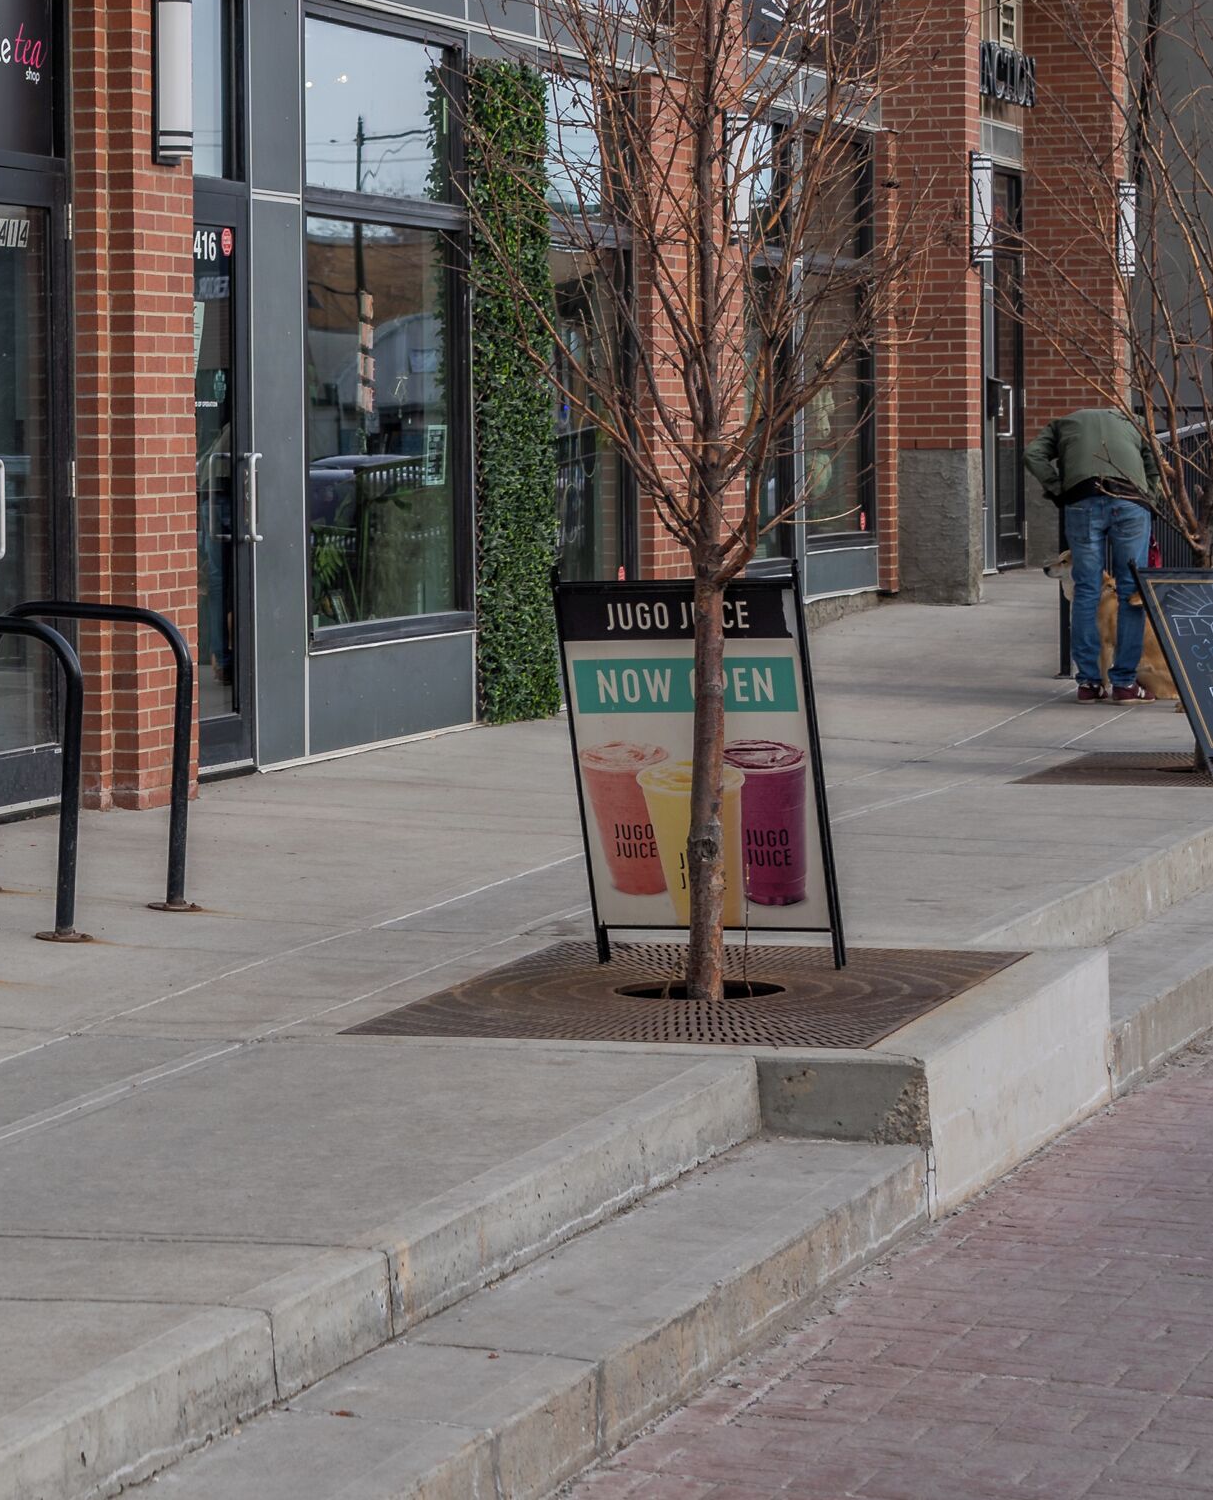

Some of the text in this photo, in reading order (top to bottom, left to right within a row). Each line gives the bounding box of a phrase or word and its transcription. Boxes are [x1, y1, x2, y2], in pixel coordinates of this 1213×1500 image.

[13, 22, 48, 69] tea
[25, 67, 41, 84] shop
[606, 601, 750, 631] JUGO JCE
[595, 666, 775, 704] NOW EN
[614, 823, 654, 840] JUGO
[746, 828, 789, 847] JUGO
[616, 841, 657, 859] JUICE
[748, 848, 793, 867] JUICE
